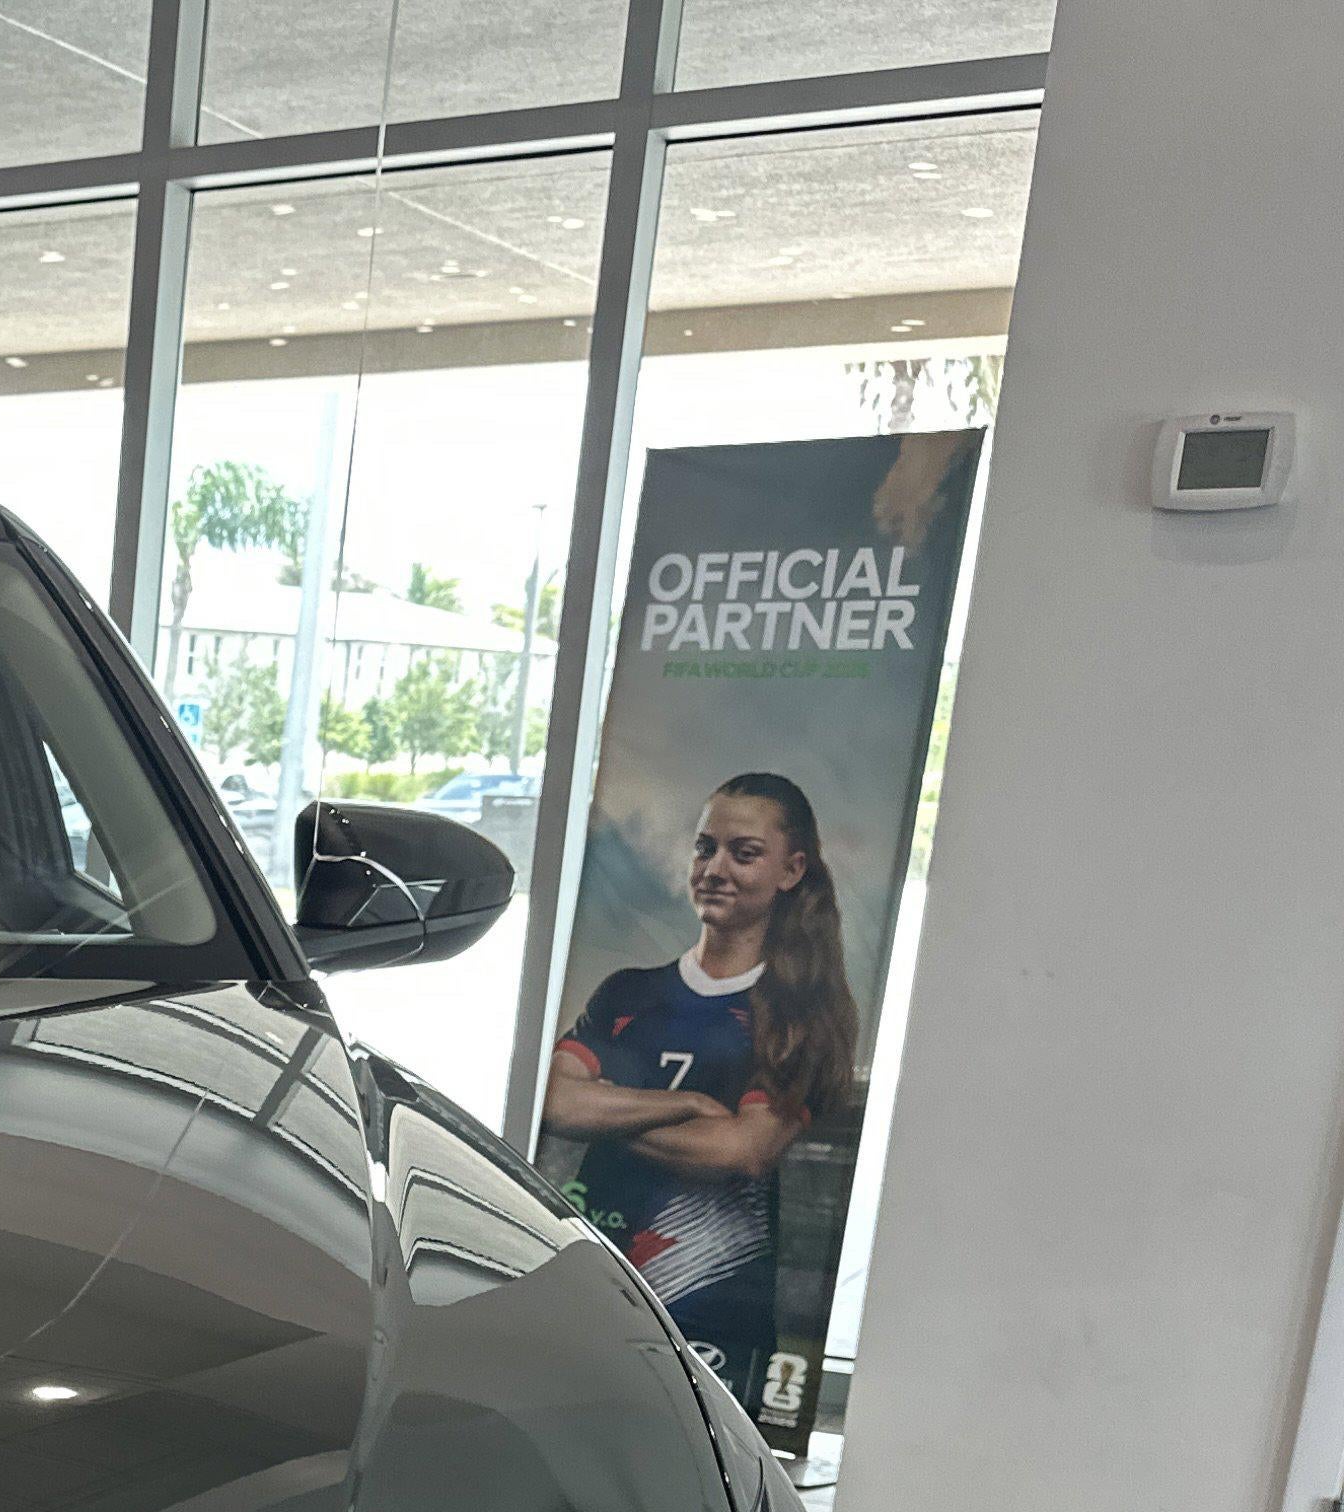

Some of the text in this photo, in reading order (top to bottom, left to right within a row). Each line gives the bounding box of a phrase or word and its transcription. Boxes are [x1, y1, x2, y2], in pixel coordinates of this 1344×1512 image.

[648, 546, 921, 601] OFFICIAL
[640, 600, 915, 652] PARTNER
[660, 1051, 695, 1091] 7
